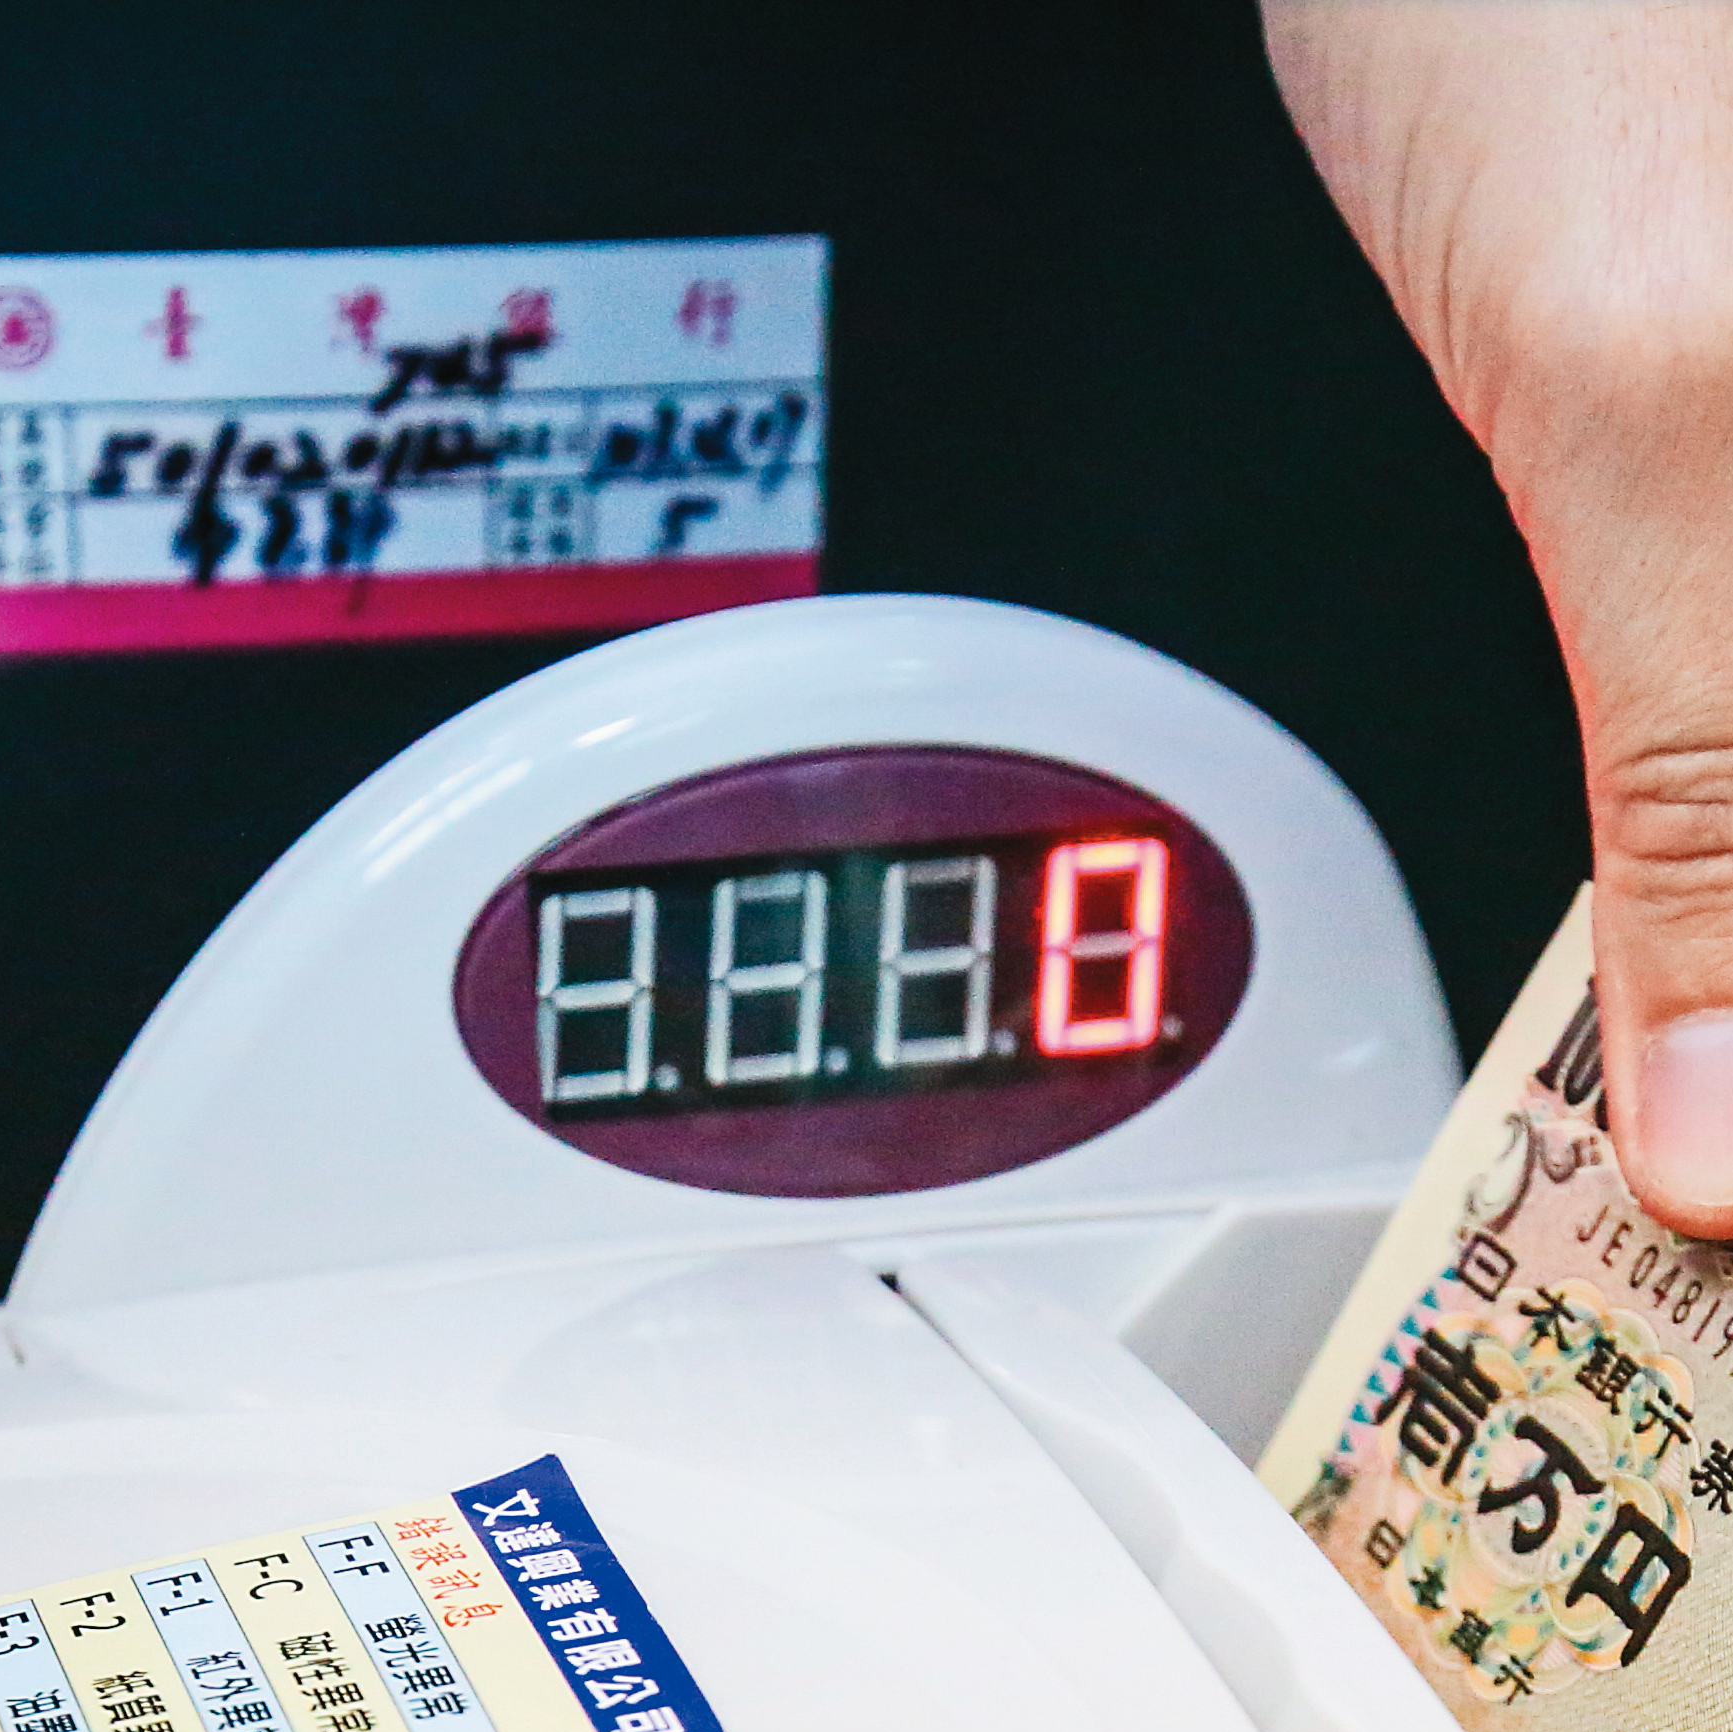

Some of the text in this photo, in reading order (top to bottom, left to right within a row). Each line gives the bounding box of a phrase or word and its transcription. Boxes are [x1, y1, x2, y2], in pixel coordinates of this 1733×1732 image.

[1038, 836, 1169, 1058] 0
[59, 1590, 126, 1638] F-2
[146, 1571, 214, 1616] F-1
[233, 1552, 304, 1600] F-C
[318, 1535, 467, 1719] F-F 螢光異常
[394, 1517, 503, 1628] 錯誤訊息
[1363, 1518, 1538, 1705] 日本銀行
